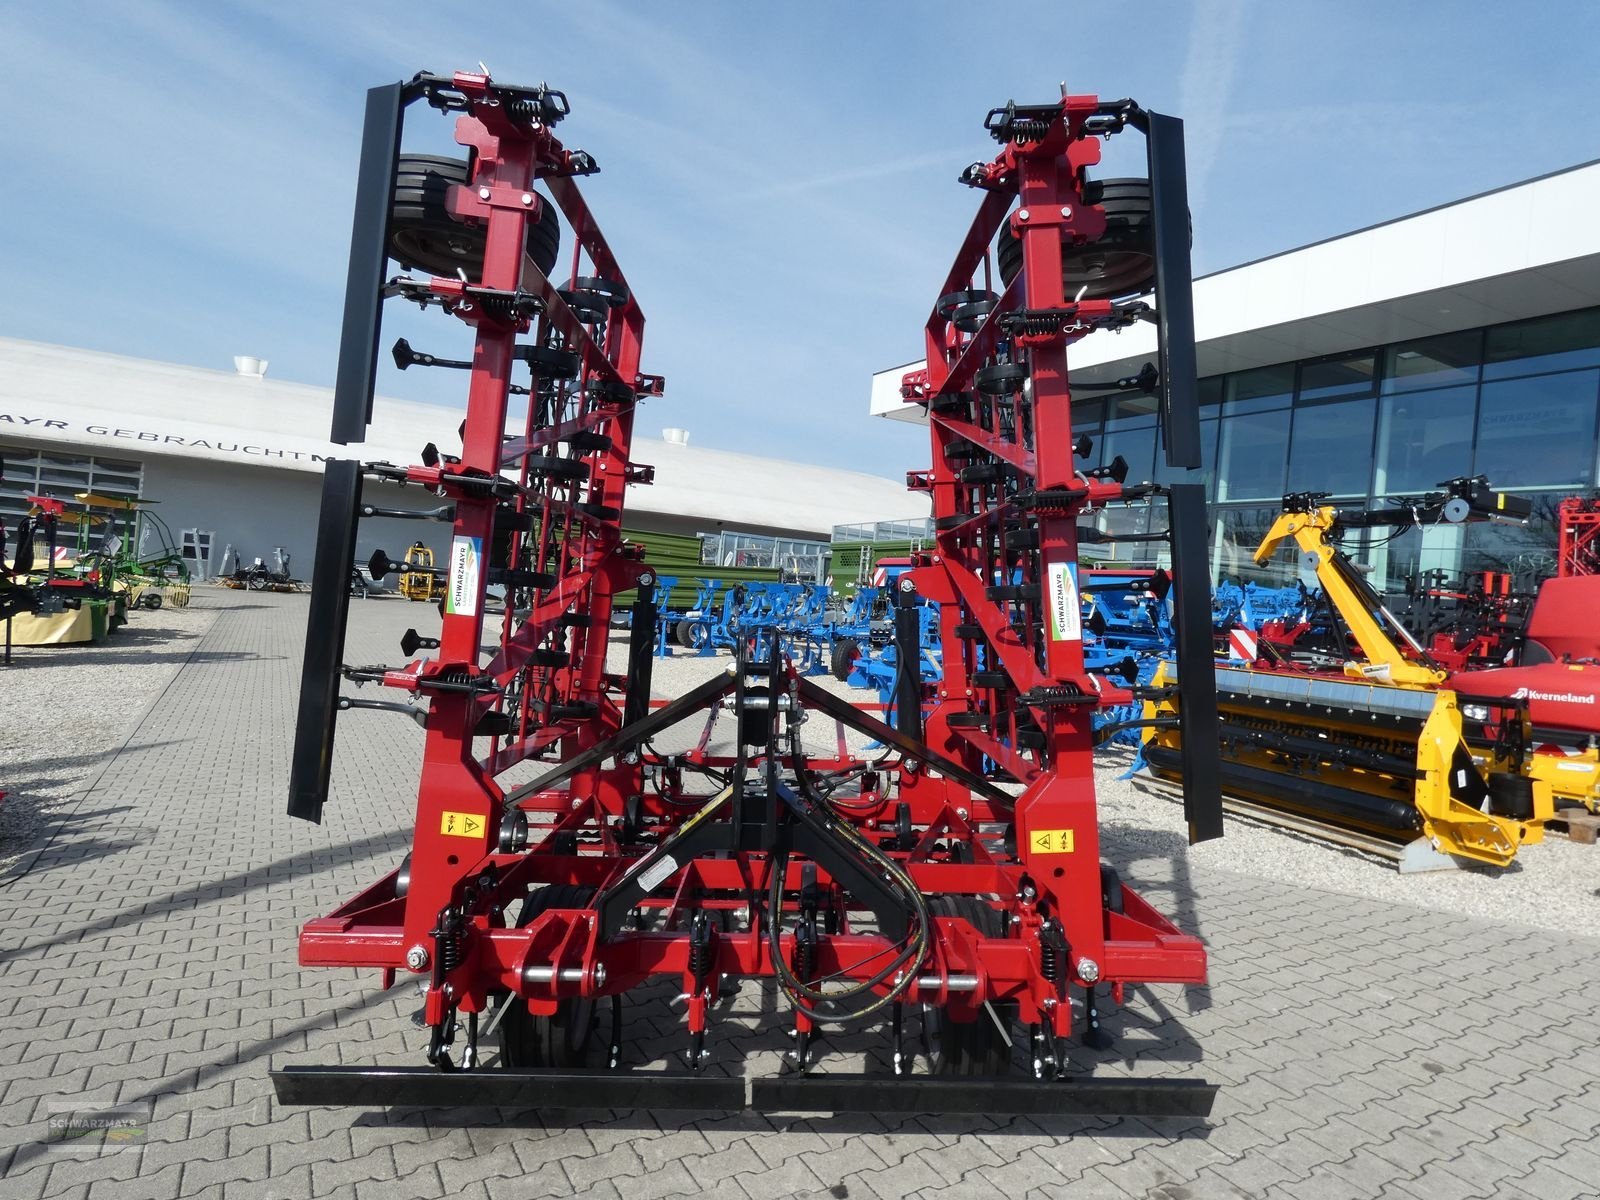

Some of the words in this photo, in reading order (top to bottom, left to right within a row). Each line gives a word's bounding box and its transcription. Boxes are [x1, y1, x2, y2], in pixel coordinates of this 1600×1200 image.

[0, 414, 69, 429] AYR
[86, 425, 336, 462] GEBRAUCHTM
[1482, 408, 1568, 425] CHWARZMAYR
[455, 547, 466, 607] SCHWARZMAYR
[1056, 574, 1065, 633] SCHWARZMAYR
[1529, 690, 1595, 704] Kverneland
